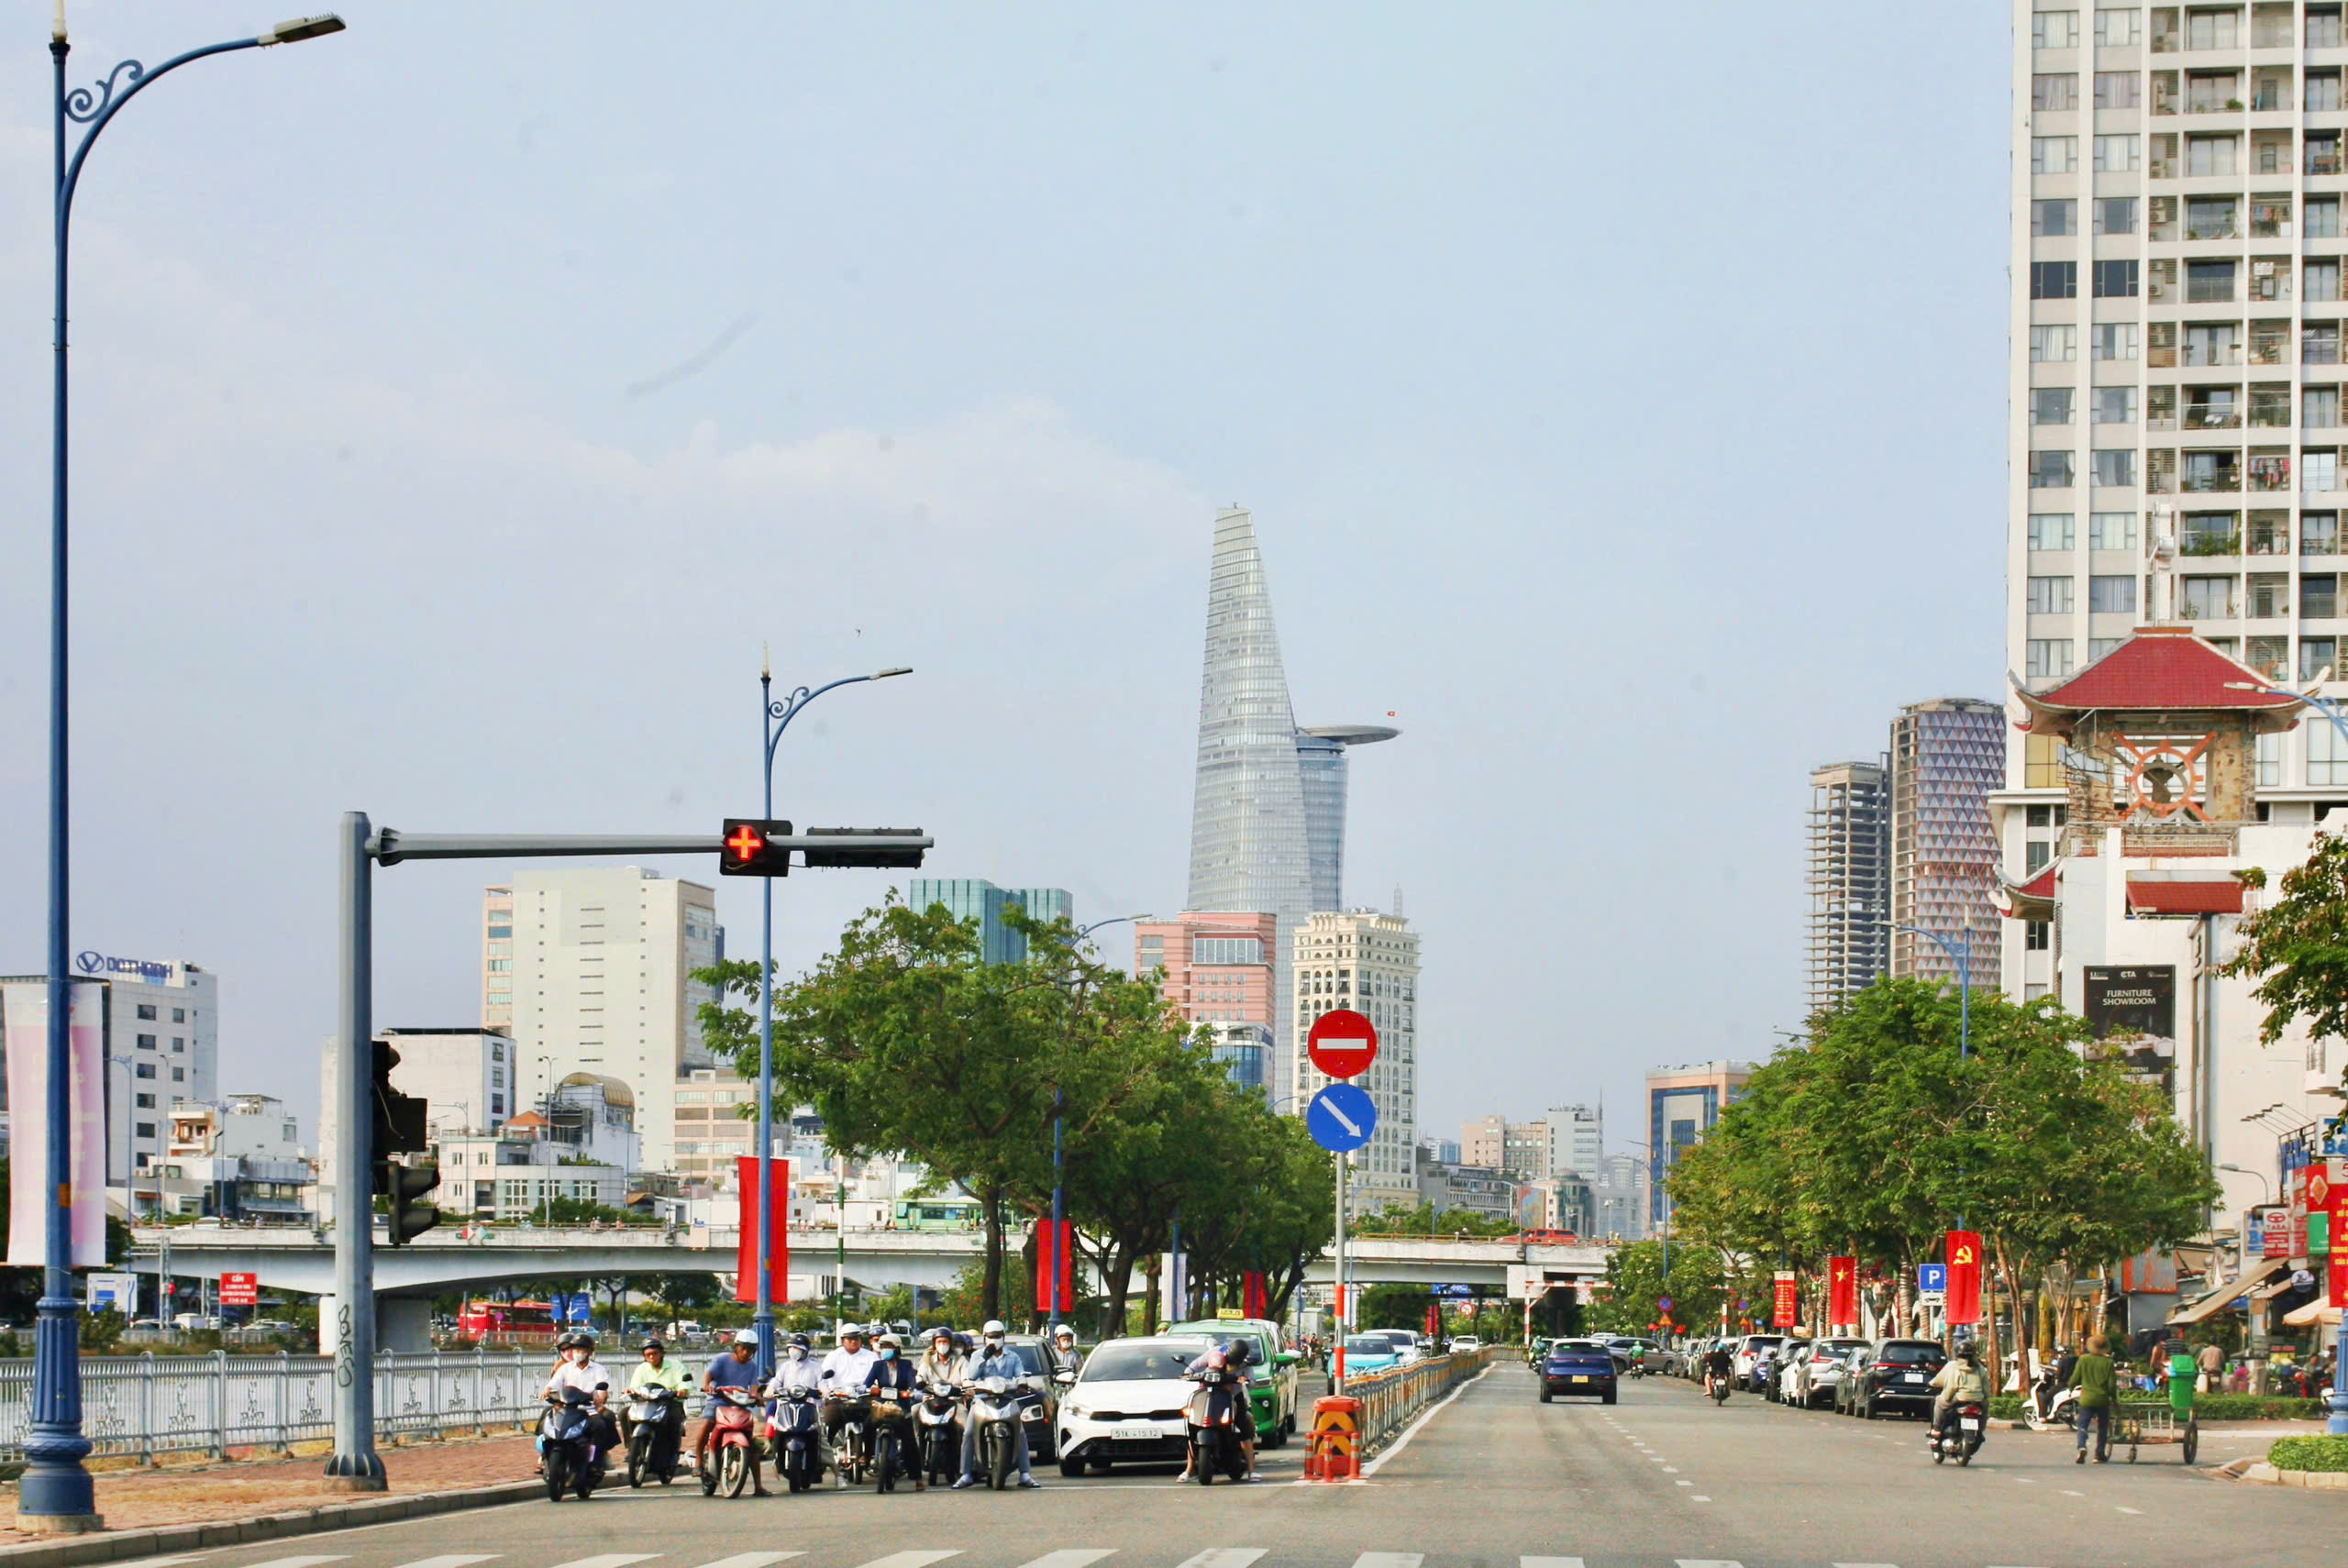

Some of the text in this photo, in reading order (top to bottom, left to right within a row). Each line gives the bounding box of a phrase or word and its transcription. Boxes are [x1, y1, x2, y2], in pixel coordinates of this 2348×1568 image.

[2106, 989, 2153, 998] FURNITURE
[2102, 997, 2156, 1006] SHOWROOM
[1929, 1269, 1941, 1285] P
